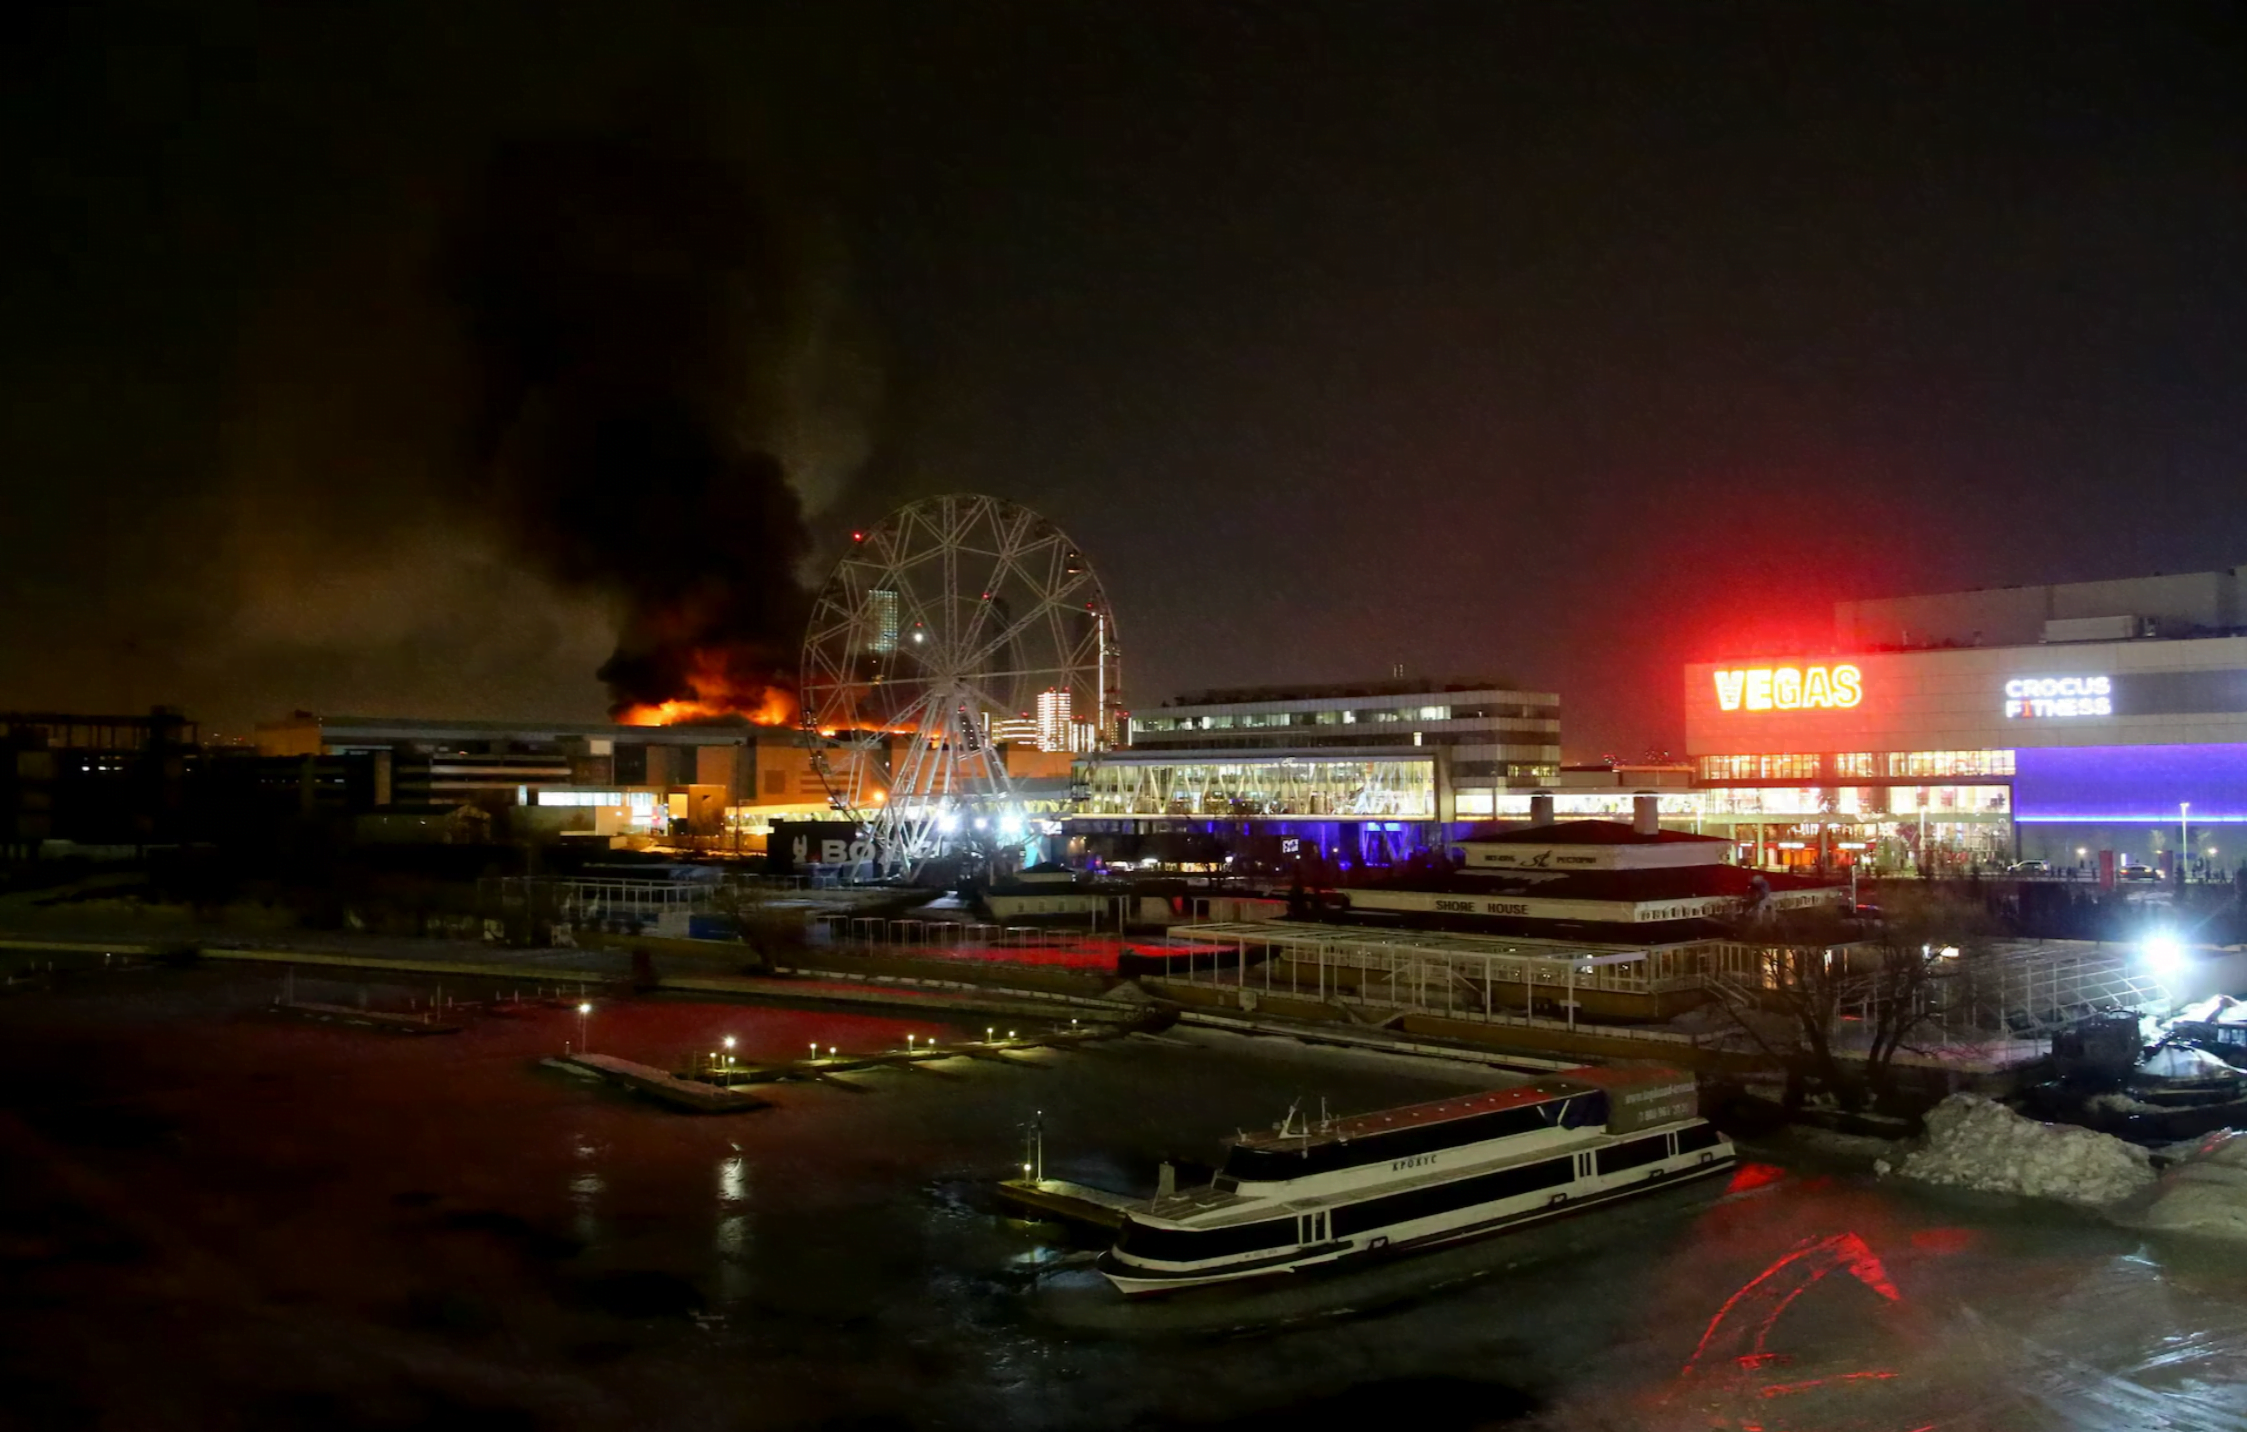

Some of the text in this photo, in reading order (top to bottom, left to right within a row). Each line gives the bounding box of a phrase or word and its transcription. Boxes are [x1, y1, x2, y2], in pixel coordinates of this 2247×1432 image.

[1714, 665, 1862, 711] VEGAS
[2005, 676, 2111, 698] CROCUS
[1435, 900, 1529, 915] SHORE HOUSE
